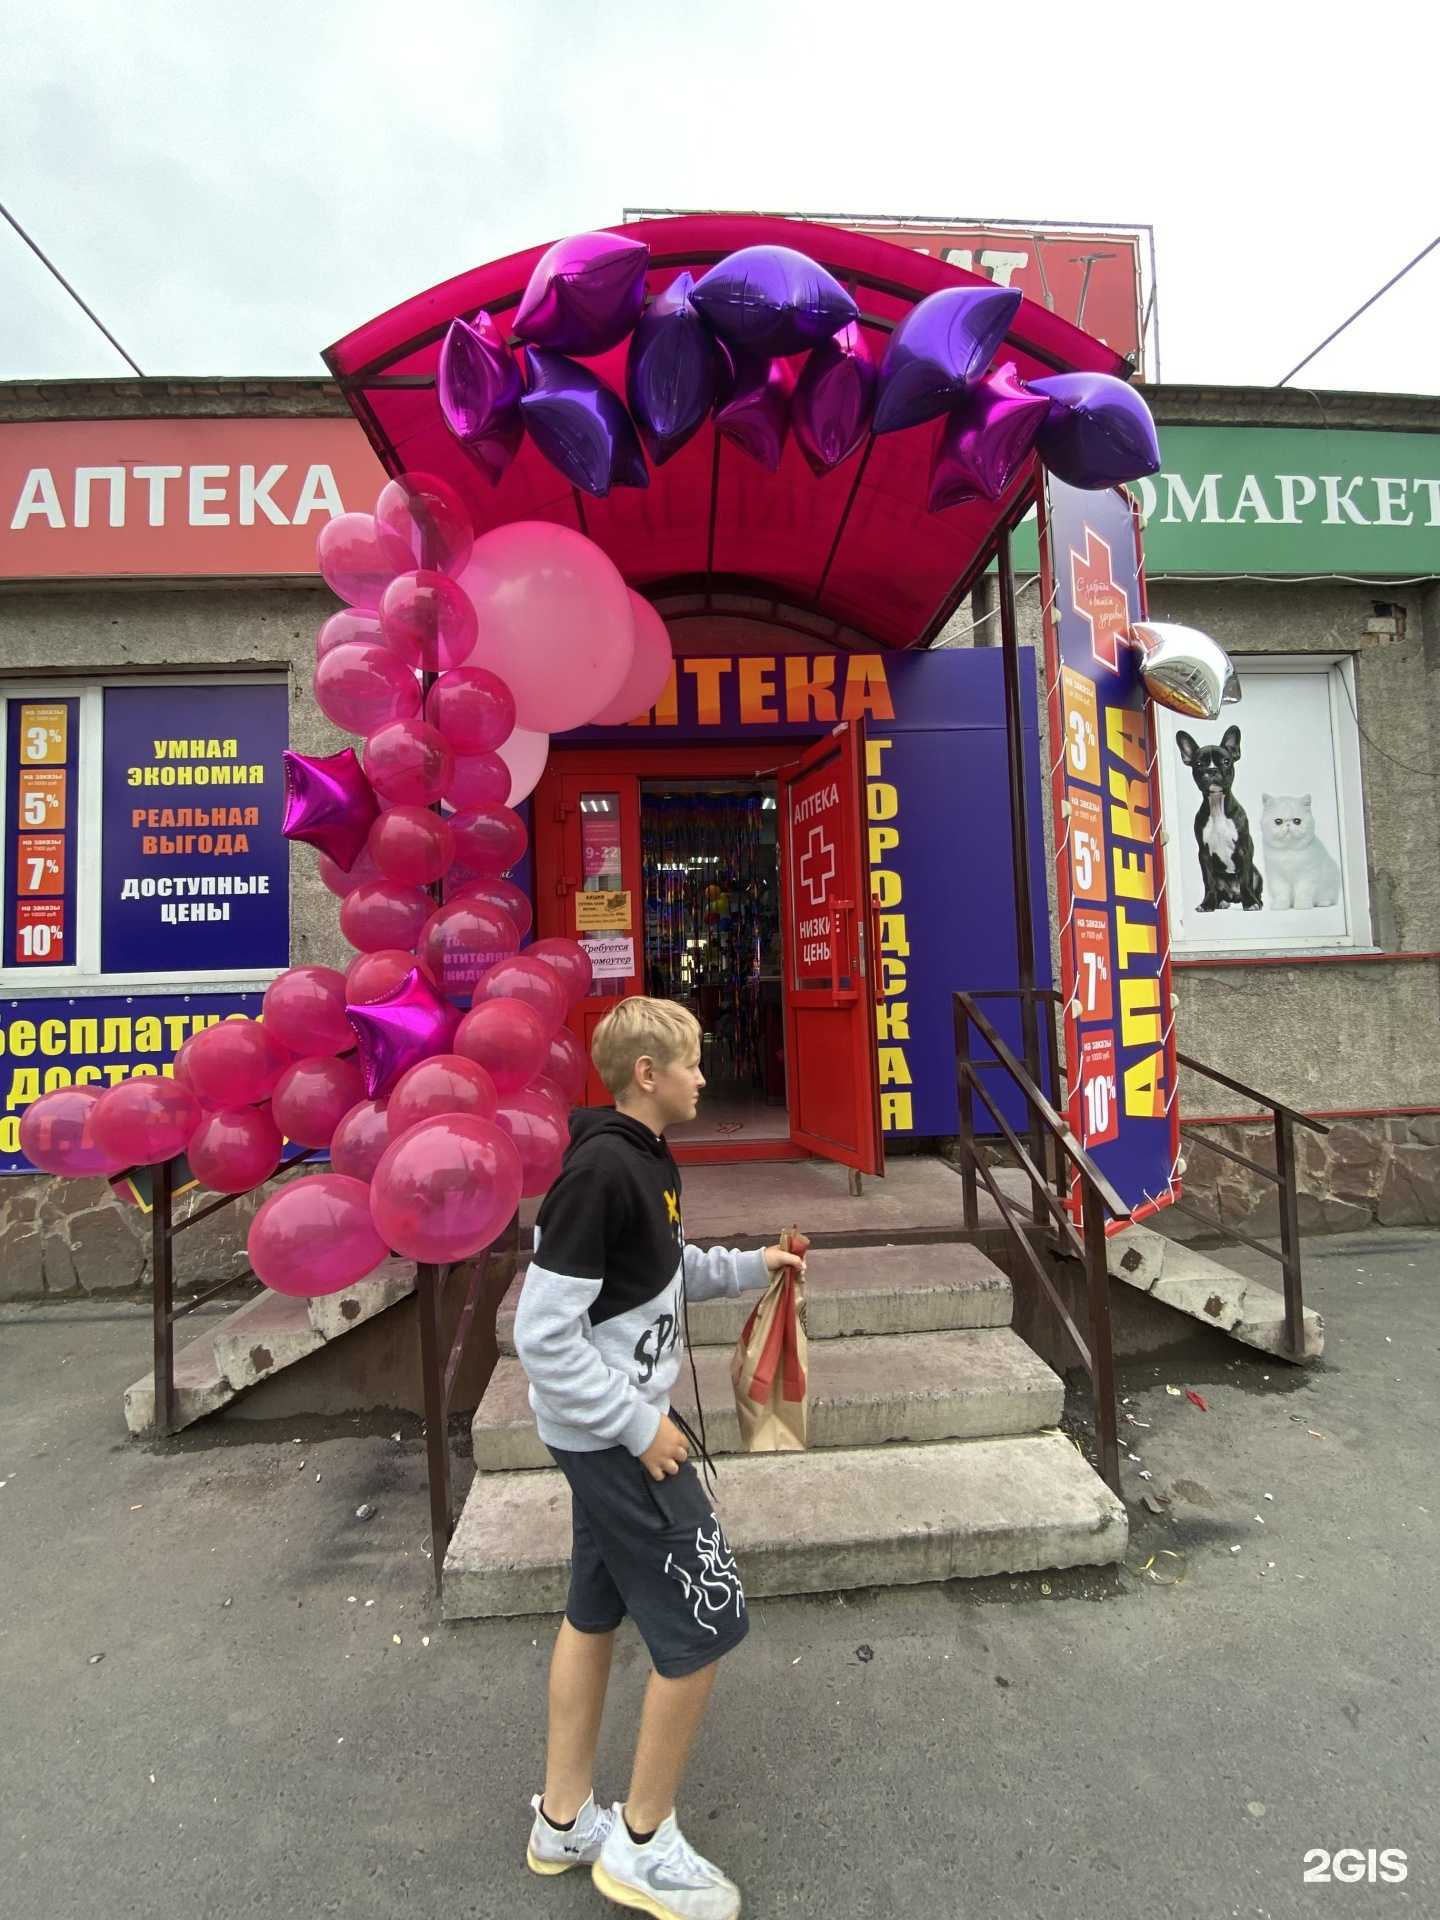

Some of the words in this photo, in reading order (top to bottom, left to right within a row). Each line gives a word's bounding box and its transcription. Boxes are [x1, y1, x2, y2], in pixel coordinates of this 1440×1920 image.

[10, 464, 346, 530] АПТЕКА
[628, 654, 896, 726] ТЕКА
[27, 727, 61, 760] 3%
[153, 739, 237, 759] УМНАЯ
[1069, 710, 1095, 771] 3%
[127, 765, 264, 786] ЭКОНОМИЯ
[24, 792, 58, 825] 5%
[132, 807, 259, 828] РЕАЛЬНАЯ
[794, 783, 840, 826] АПТЕКА
[143, 834, 249, 856] ВЫГОДА
[1074, 830, 1100, 890] 5%
[27, 857, 59, 890] 7%
[121, 876, 269, 899] ДОСТУПНЫЕ
[161, 903, 229, 925] ЦЕНЫ
[800, 916, 831, 939] НИЗКИ
[1105, 706, 1167, 1118] АПТЕКА
[18, 924, 63, 956] 10%
[865, 740, 913, 1130] ГОРОДСКАЯ
[592, 957, 632, 966] омоутер
[1083, 952, 1107, 1011] 7%
[0, 1012, 264, 1057] есплат
[1085, 1075, 1116, 1136] 10%
